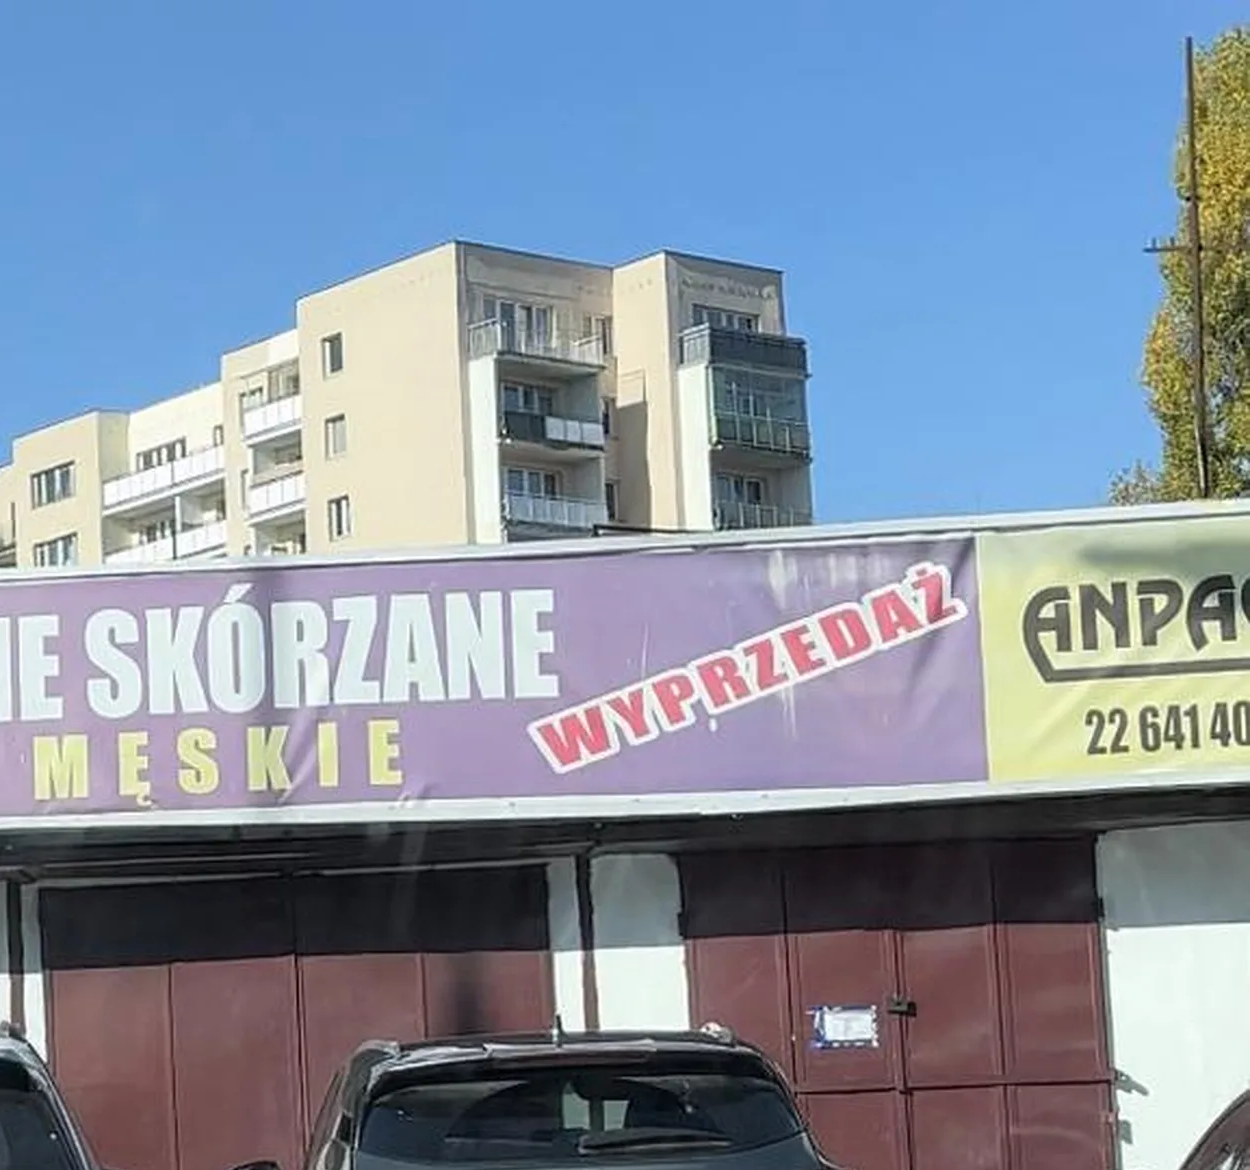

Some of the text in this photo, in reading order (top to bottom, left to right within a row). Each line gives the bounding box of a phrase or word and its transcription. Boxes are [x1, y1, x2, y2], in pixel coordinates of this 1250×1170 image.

[85, 583, 560, 720] SKÓRZANE
[537, 567, 959, 766] WYPRZEDAŻ
[1022, 574, 1250, 682] ANPA
[32, 719, 403, 807] MĘSKIE
[1085, 707, 1129, 755] 22
[1139, 703, 1201, 752] 641
